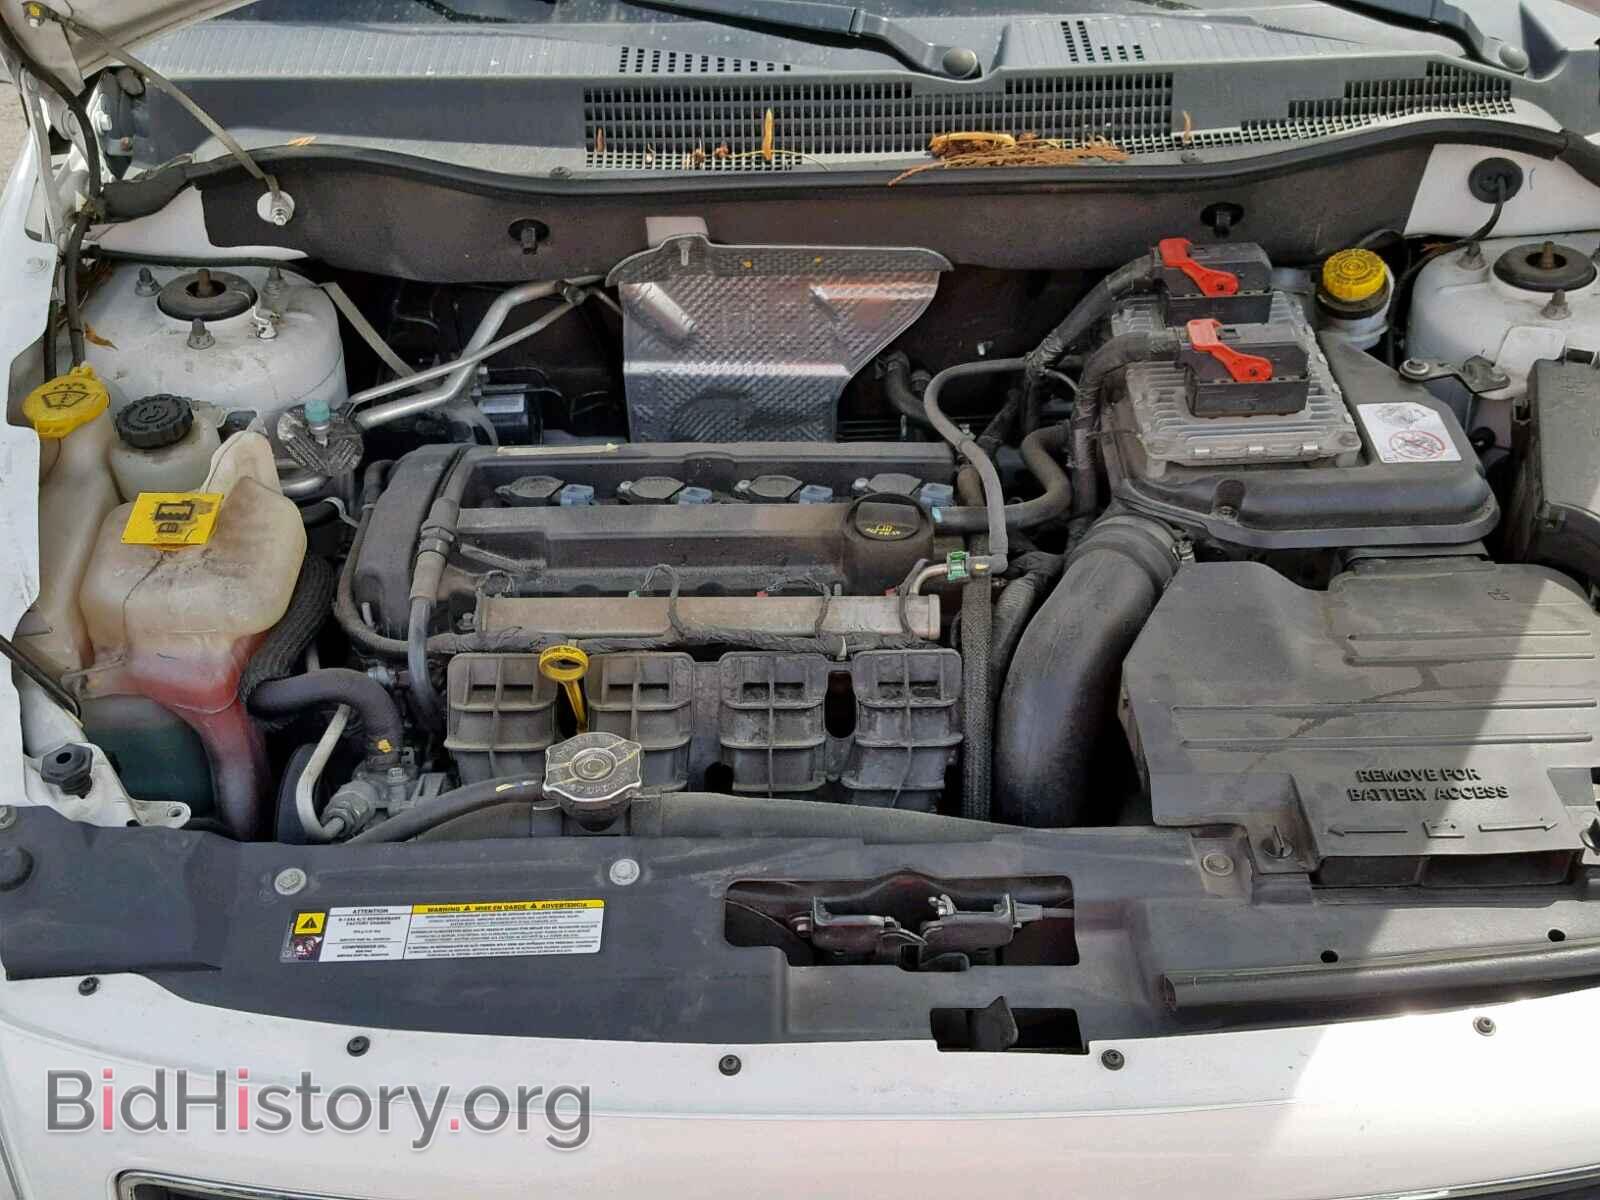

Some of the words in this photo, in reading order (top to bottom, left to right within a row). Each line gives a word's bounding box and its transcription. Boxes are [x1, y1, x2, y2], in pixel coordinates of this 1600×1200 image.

[1356, 768, 1438, 782] REMOVE
[1440, 768, 1481, 781] FOR
[1347, 787, 1427, 801] BATTERY
[1434, 785, 1509, 800] ACCESS
